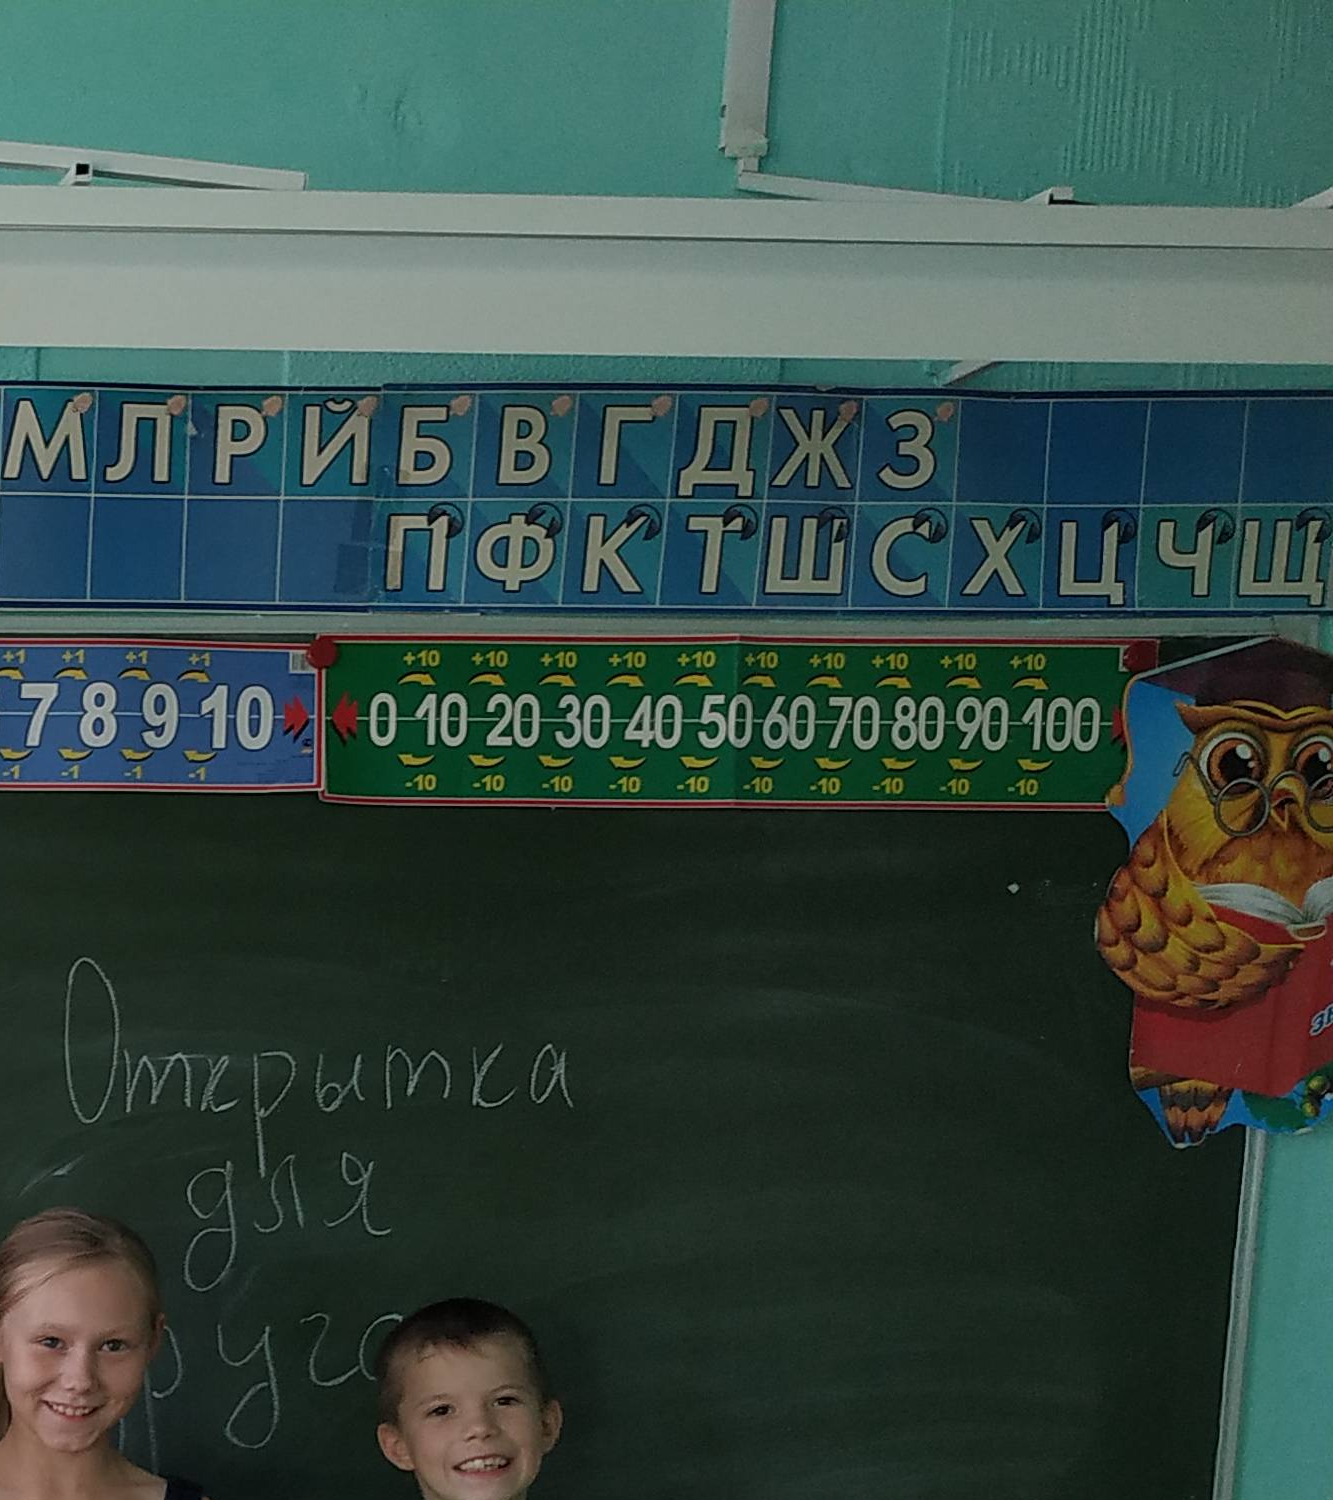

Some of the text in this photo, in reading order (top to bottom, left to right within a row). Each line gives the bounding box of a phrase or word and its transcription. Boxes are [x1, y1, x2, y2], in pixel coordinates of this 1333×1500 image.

[2, 399, 90, 481] М
[104, 402, 173, 483] Л
[212, 403, 267, 485] Р
[302, 399, 372, 486] Й
[396, 405, 452, 485] Б
[496, 404, 552, 486] В
[597, 404, 656, 486] Г
[677, 405, 758, 497] Д
[770, 406, 854, 490] Ж
[877, 408, 936, 491] З
[384, 514, 449, 592] П
[475, 509, 556, 592] Ф
[582, 514, 645, 594] К
[686, 515, 745, 594] Т
[763, 516, 847, 595] Ш
[870, 515, 931, 597] С
[961, 518, 1029, 596] Х
[1057, 518, 1127, 606] Ц
[1156, 519, 1217, 597] Ч
[1236, 518, 1325, 607] Щ
[3, 649, 27, 664] +1
[61, 649, 85, 664] +1
[125, 650, 149, 665] +1
[188, 652, 212, 667] +1
[403, 650, 1047, 671] +10 +10 +10 +10 +10 +10 +10 +10 +10 +10
[20, 682, 60, 747] 7
[79, 681, 118, 748] 8
[141, 682, 179, 749] 9
[200, 684, 274, 751] 10
[369, 692, 1101, 752] 0 10 20 30 40 50 60 70 80 90 100
[2, 764, 21, 779] -1
[61, 764, 80, 780] -1
[124, 765, 143, 780] -1
[188, 766, 207, 781] -1
[404, 774, 1039, 796] -10 -10 -10 -10 -10 -10 -10 -10 -10 -10
[65, 956, 575, 1178] Открытка
[183, 1151, 393, 1293] для
